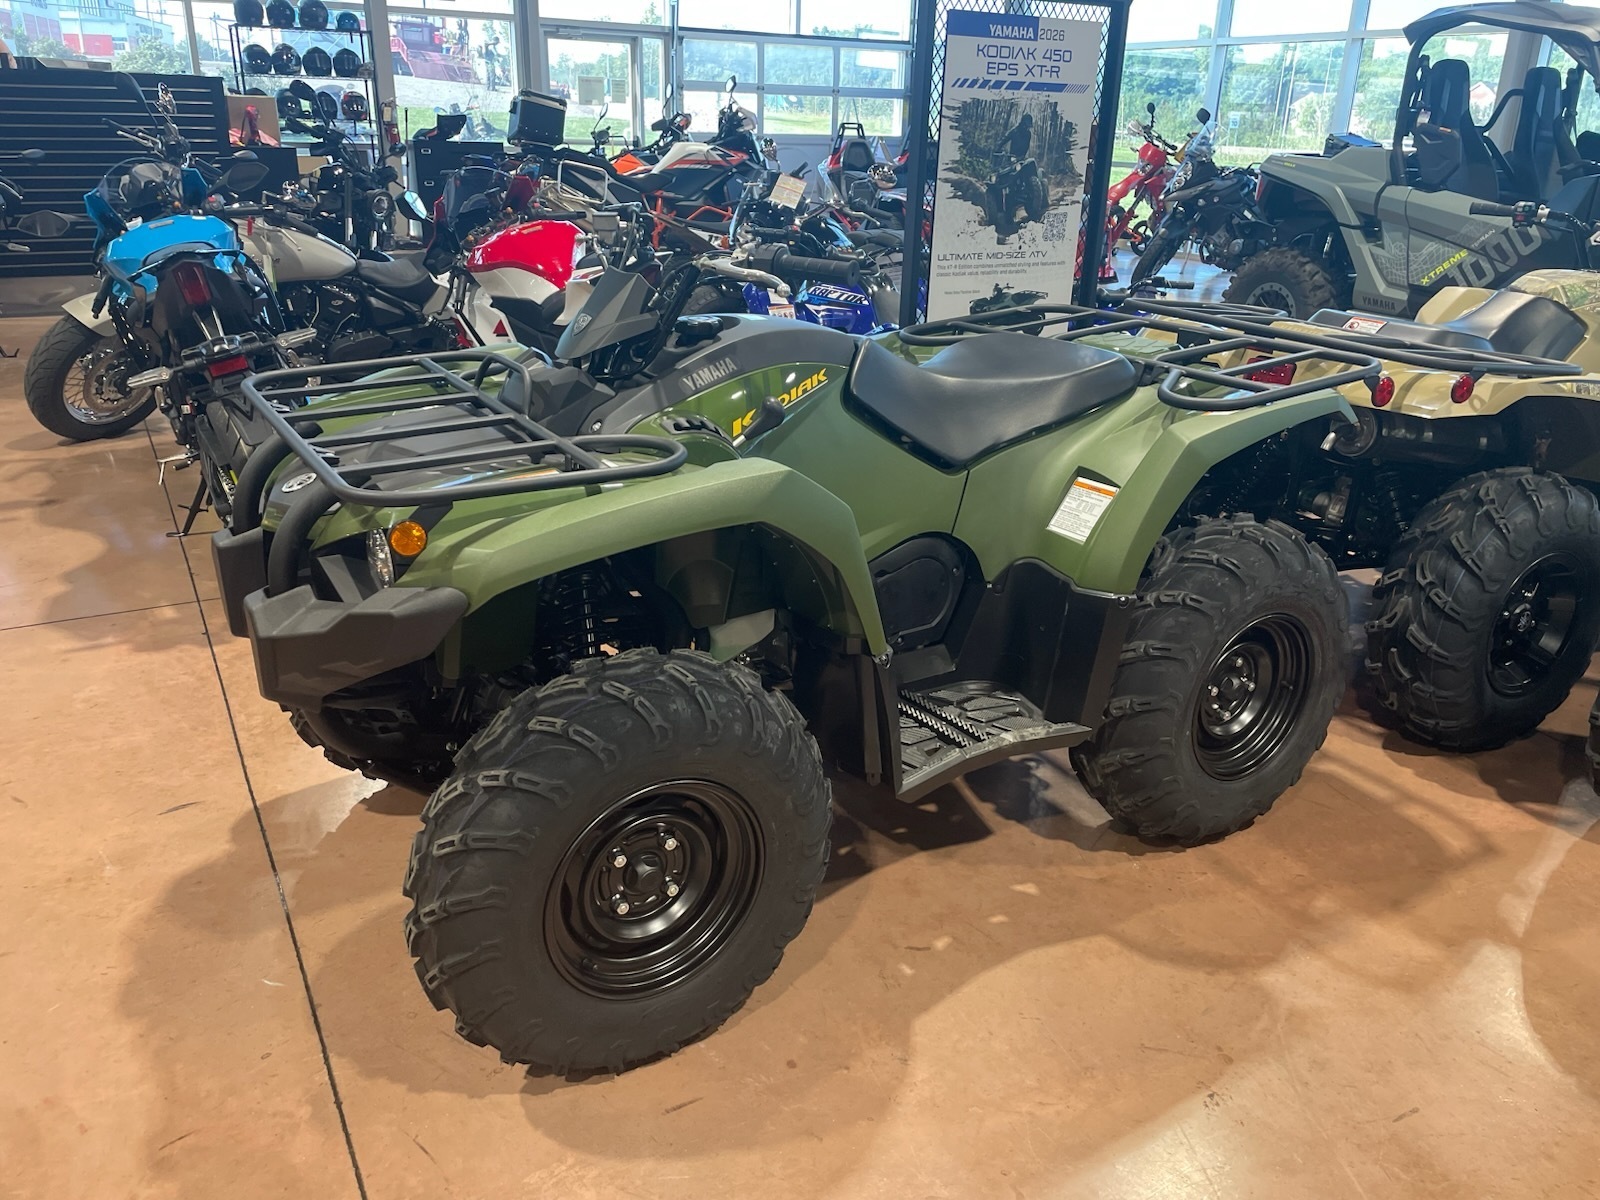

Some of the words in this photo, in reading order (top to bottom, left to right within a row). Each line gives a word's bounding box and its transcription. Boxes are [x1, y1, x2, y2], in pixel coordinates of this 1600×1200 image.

[989, 24, 1034, 39] YAMAHA
[1039, 28, 1065, 41] 2026
[976, 43, 1037, 60] KODIAK
[1042, 49, 1072, 63] 450
[986, 62, 1019, 76] EPS
[1024, 64, 1061, 79] XT-R
[937, 252, 983, 261] ULTIMATE
[986, 251, 1026, 260] MID-SIZE
[1029, 250, 1048, 258] ATV
[1420, 248, 1469, 286] XTREME
[1471, 228, 1496, 249] TERRAIN
[1448, 224, 1543, 288] 1000
[812, 286, 865, 304] RAPTOR
[1362, 295, 1396, 311] YAMAHA
[682, 357, 738, 391] YAMAHA
[732, 367, 828, 437] KDIAK
